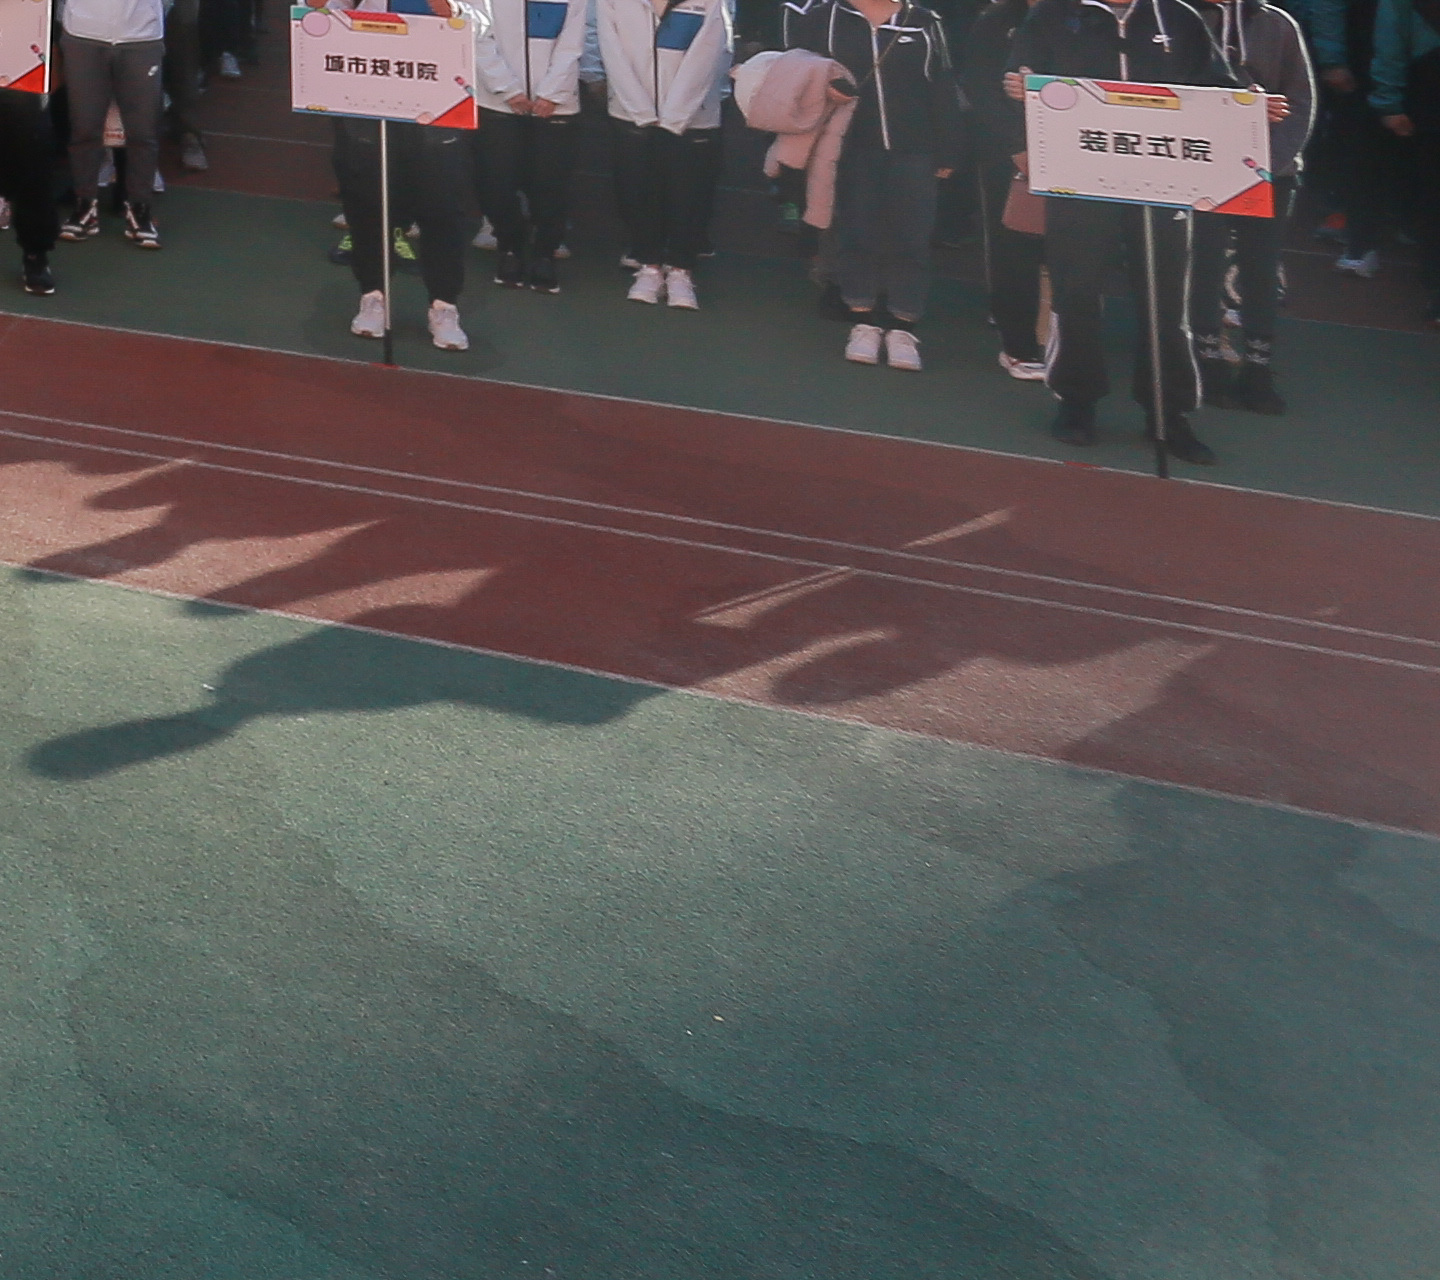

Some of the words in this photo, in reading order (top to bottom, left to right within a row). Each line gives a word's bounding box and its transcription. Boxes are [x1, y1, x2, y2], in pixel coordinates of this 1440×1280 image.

[324, 54, 439, 81] 城市规划院
[1079, 129, 1213, 163] 装配式院
